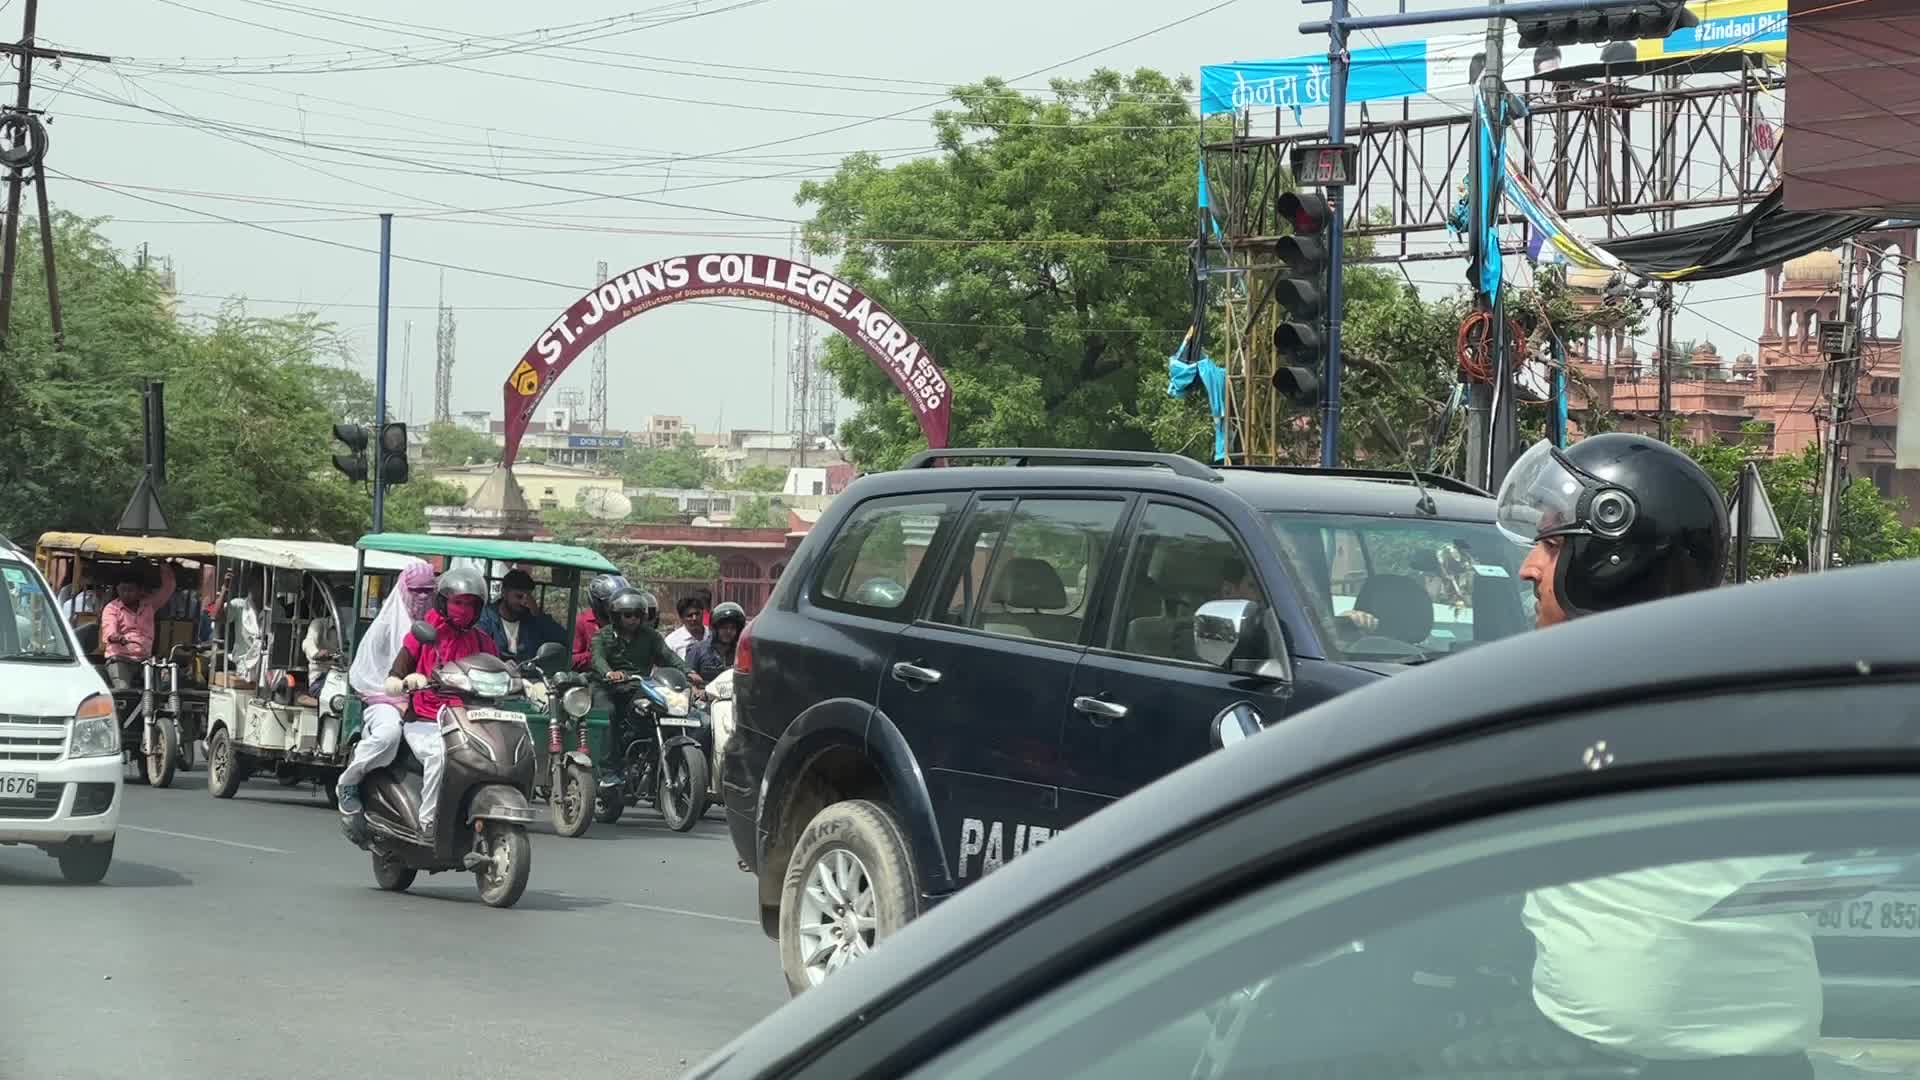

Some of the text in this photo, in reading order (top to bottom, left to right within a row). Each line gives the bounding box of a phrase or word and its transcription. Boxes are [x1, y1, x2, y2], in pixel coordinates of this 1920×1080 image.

[537, 254, 920, 377] ST. JOHN'S COLLEGE, AGRA
[909, 369, 941, 410] 1850
[0, 776, 35, 794] 1676
[1847, 901, 1873, 930] CZ
[1880, 901, 1920, 930] 855
